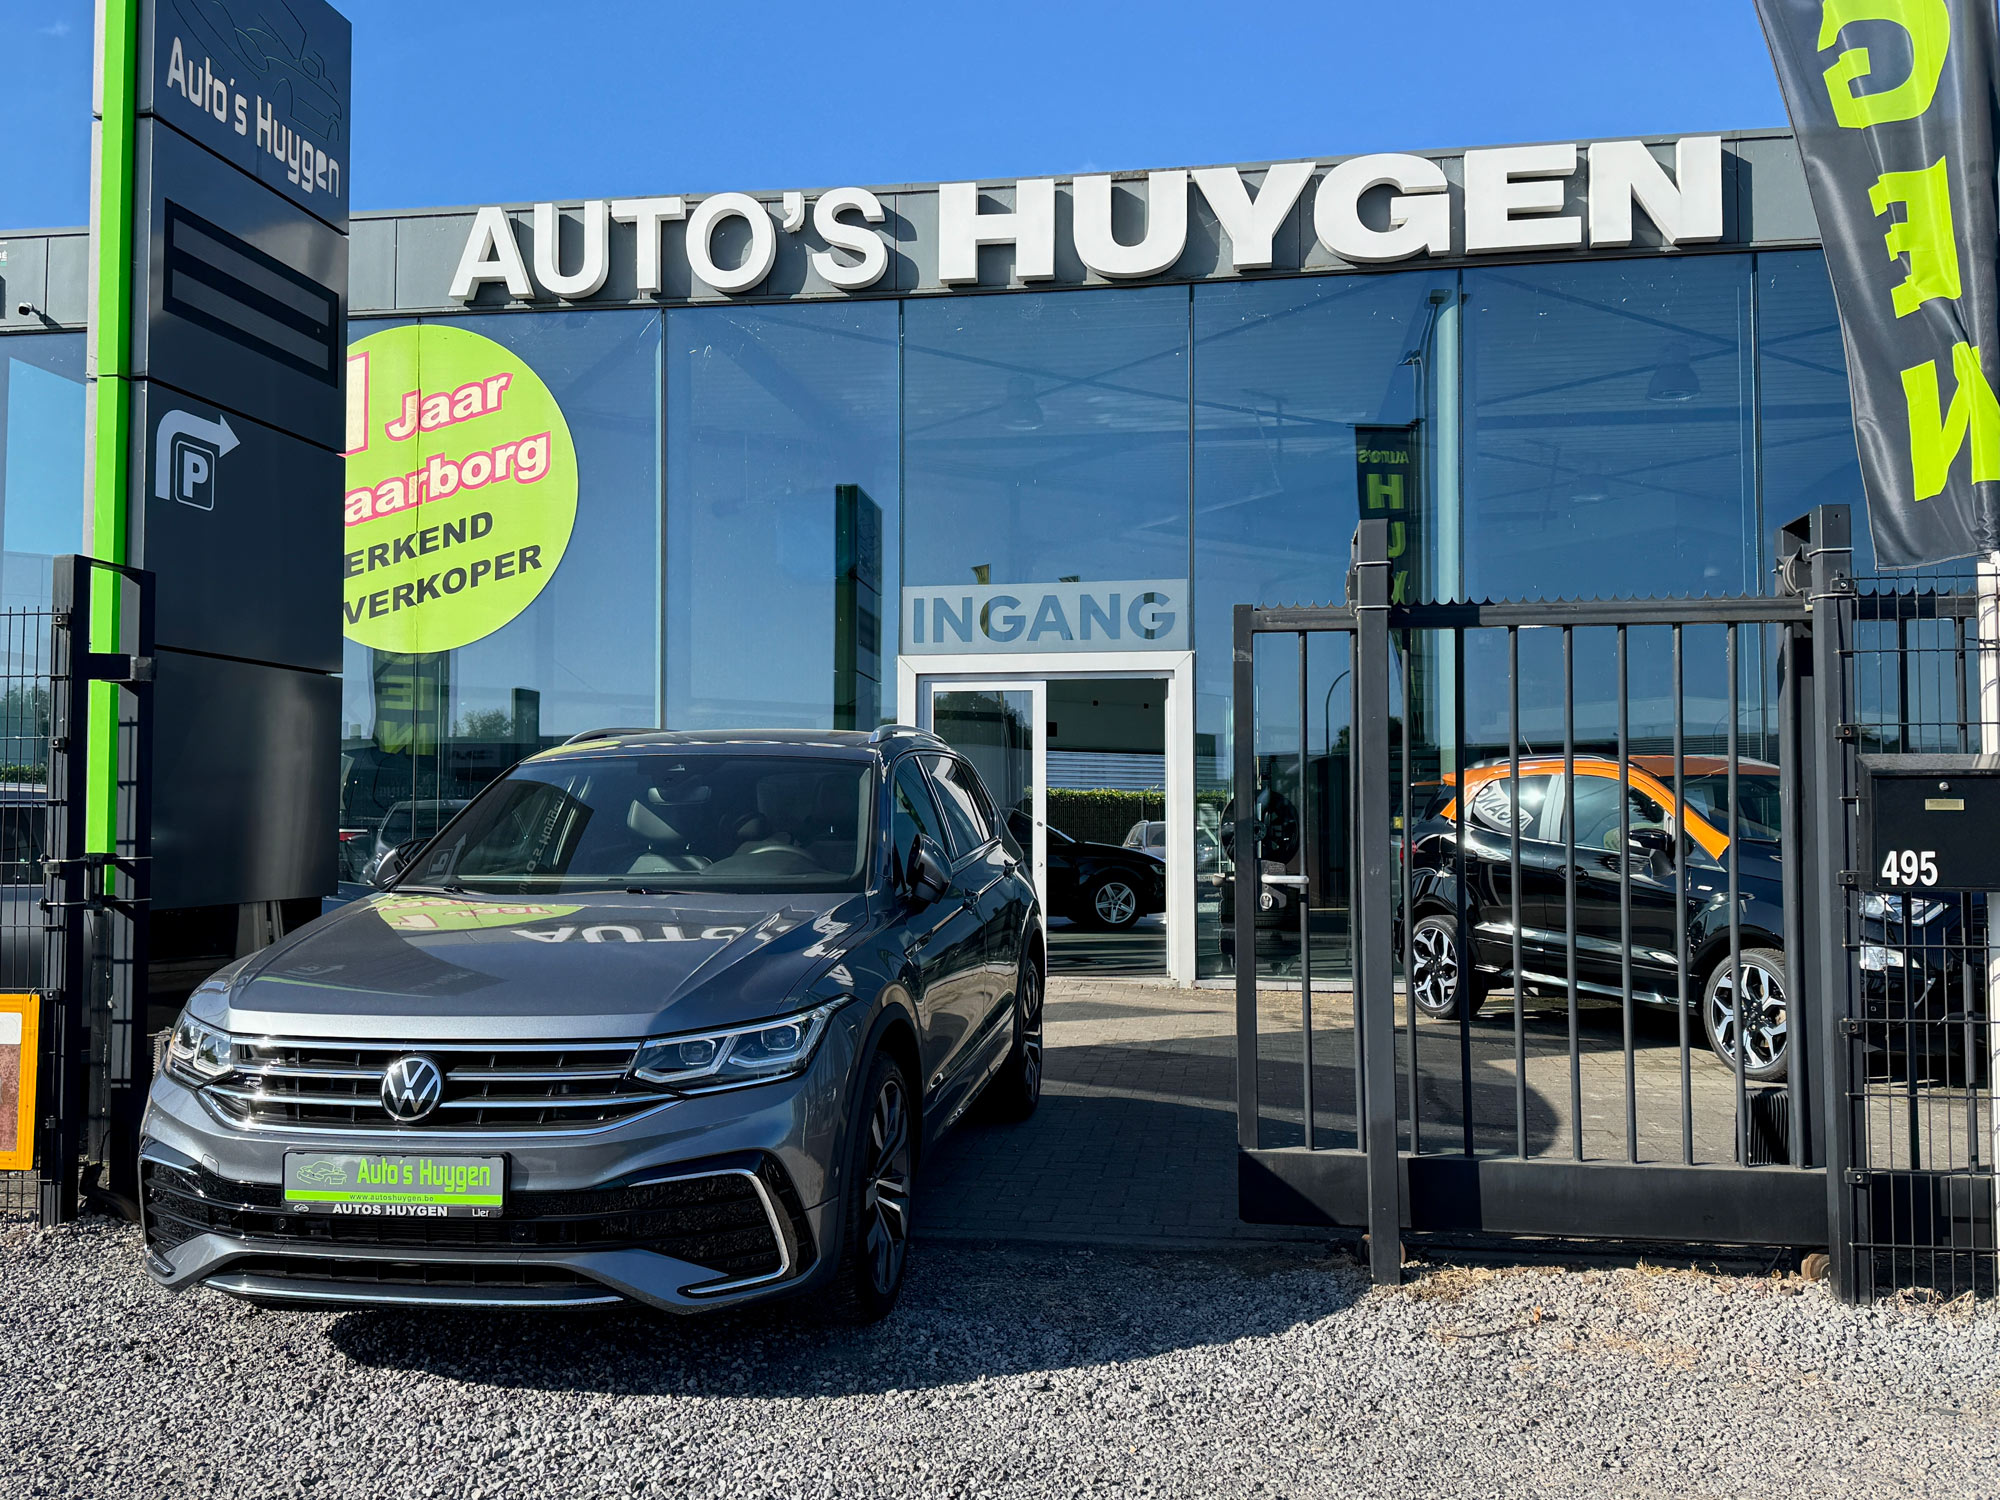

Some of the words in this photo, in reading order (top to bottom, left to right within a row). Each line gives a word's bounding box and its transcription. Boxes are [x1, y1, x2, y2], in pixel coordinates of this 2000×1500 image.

[166, 36, 248, 136] Auto's
[256, 95, 340, 198] Huygen
[448, 186, 888, 301] AUTO'S
[938, 135, 1724, 285] HUYGEN
[385, 372, 513, 442] Jaar
[183, 449, 209, 499] P
[912, 591, 1176, 644] INGANG
[1881, 850, 1938, 887] 495
[349, 1193, 434, 1203] www.autoshuygen.be
[356, 1157, 413, 1186] Auto's
[419, 1159, 491, 1193] Huygen
[332, 1203, 383, 1216] AUTOS
[386, 1205, 448, 1217] HUYGEN
